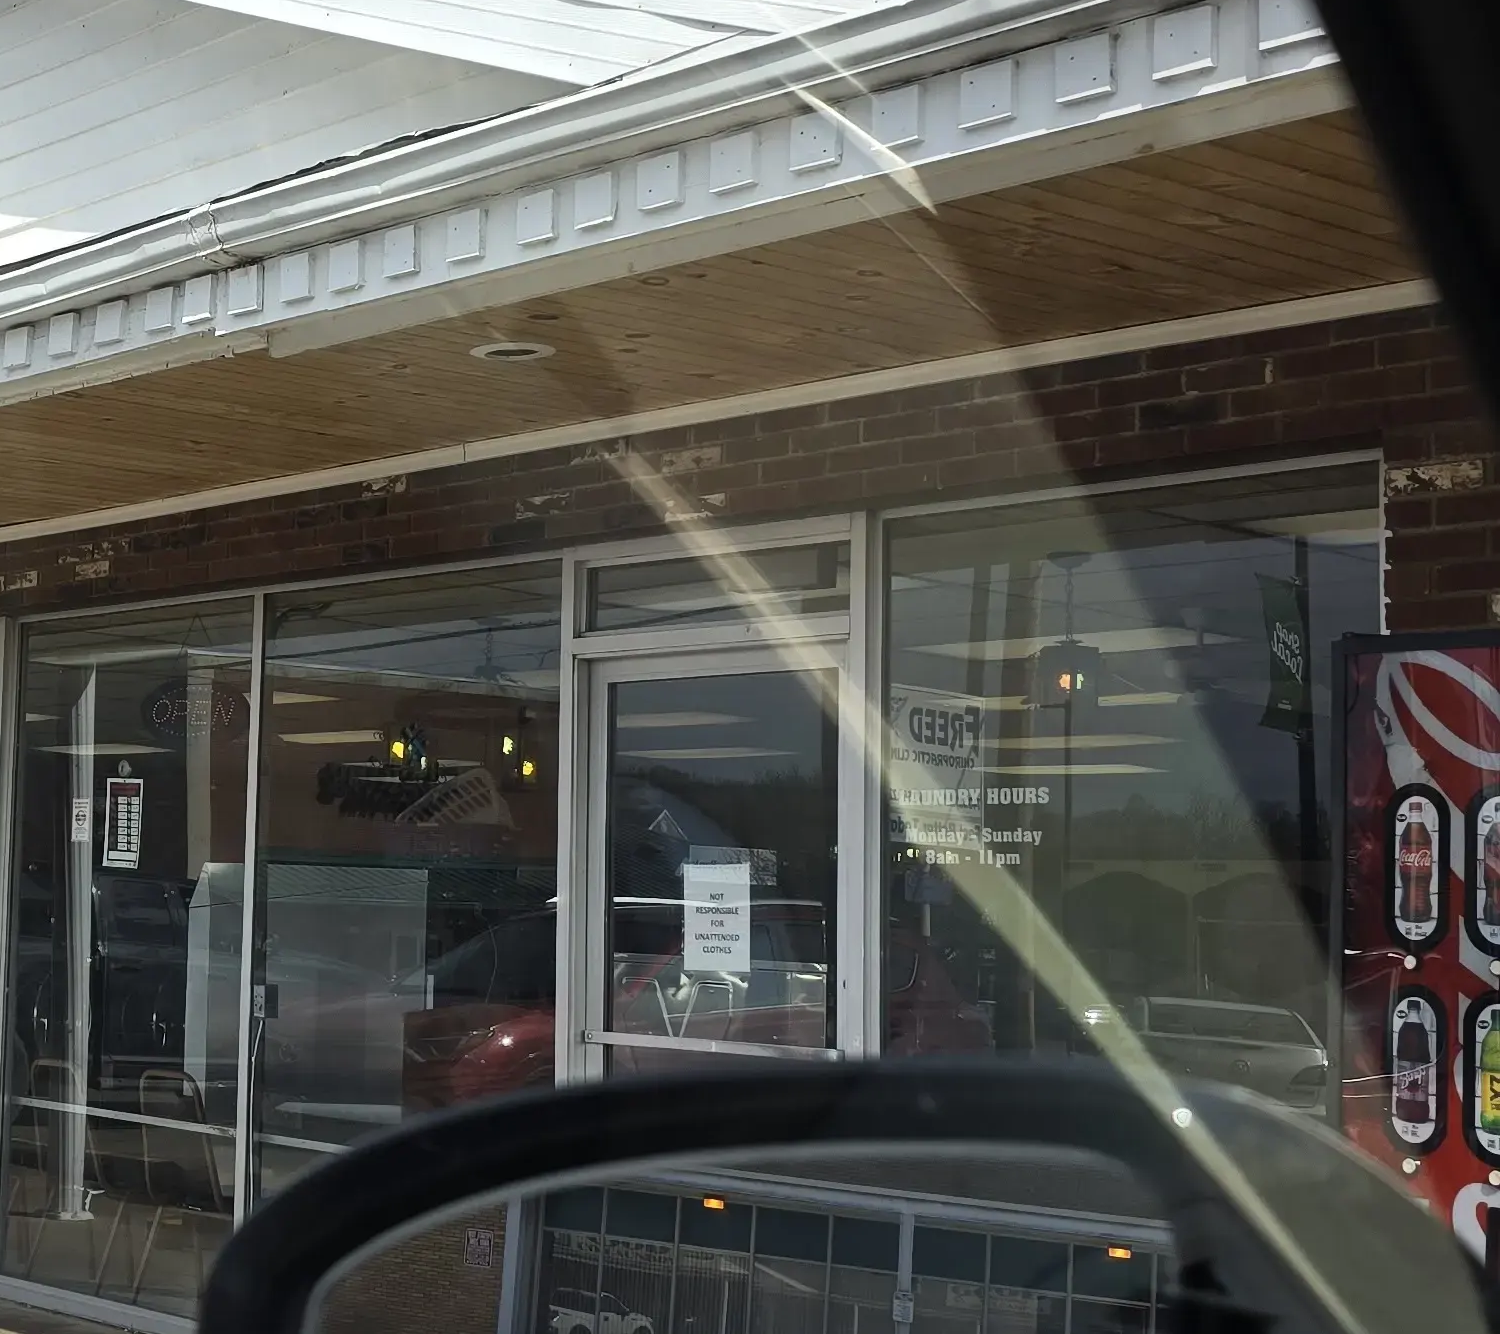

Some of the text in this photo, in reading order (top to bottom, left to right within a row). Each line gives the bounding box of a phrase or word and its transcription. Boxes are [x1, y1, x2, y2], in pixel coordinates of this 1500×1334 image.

[152, 696, 235, 727] OPEN
[900, 788, 980, 806] LAUNDRY
[986, 787, 1050, 805] HOURS
[905, 827, 966, 846] Monday
[982, 827, 1043, 846] Sunday
[925, 849, 960, 865] 8am
[979, 849, 1021, 867] 11pm
[709, 892, 725, 901] NOT
[695, 906, 740, 916] RESPONSIBLE
[710, 919, 725, 928] FOR
[694, 932, 740, 942] UNATTENDED
[702, 946, 732, 955] CLOTHES
